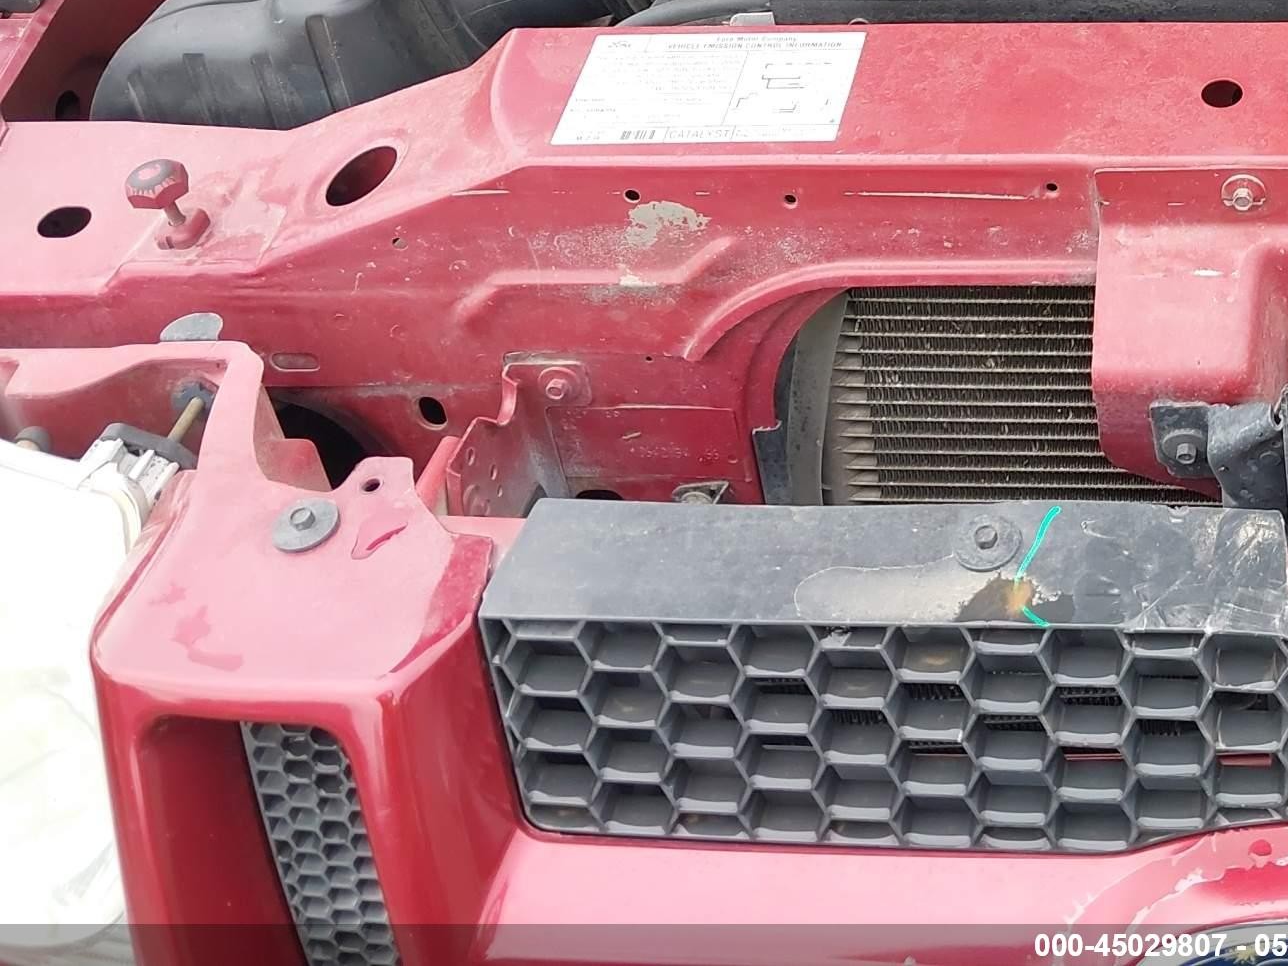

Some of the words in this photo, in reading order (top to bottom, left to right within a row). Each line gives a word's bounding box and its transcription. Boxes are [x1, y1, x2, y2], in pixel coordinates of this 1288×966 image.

[746, 42, 784, 50] CONTROL
[786, 41, 843, 49] INFORMATION
[668, 129, 732, 141] CATALYST
